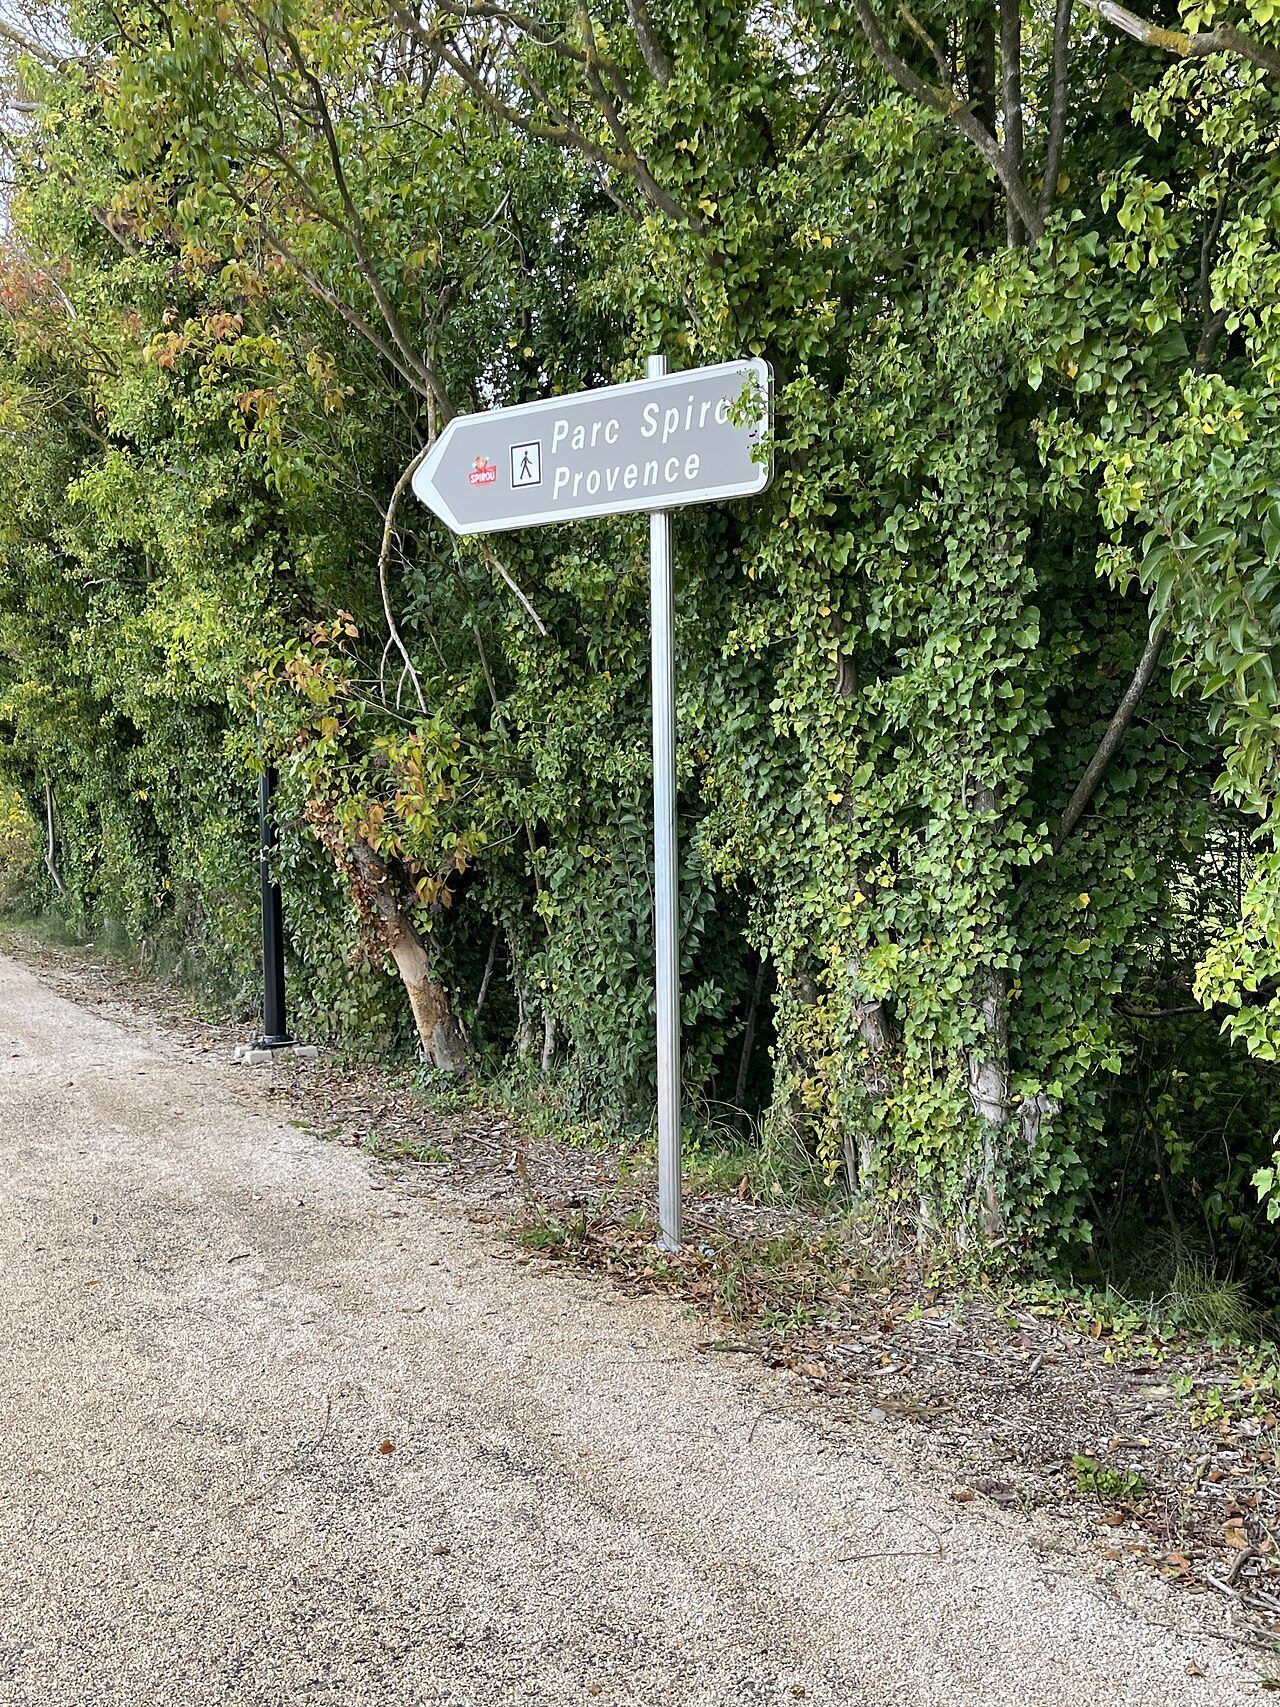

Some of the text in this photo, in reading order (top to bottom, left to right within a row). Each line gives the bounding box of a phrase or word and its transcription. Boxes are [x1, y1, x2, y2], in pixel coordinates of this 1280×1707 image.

[551, 395, 746, 454] Parc Spiro
[470, 470, 495, 484] SPIROU
[552, 453, 700, 500] Provence
